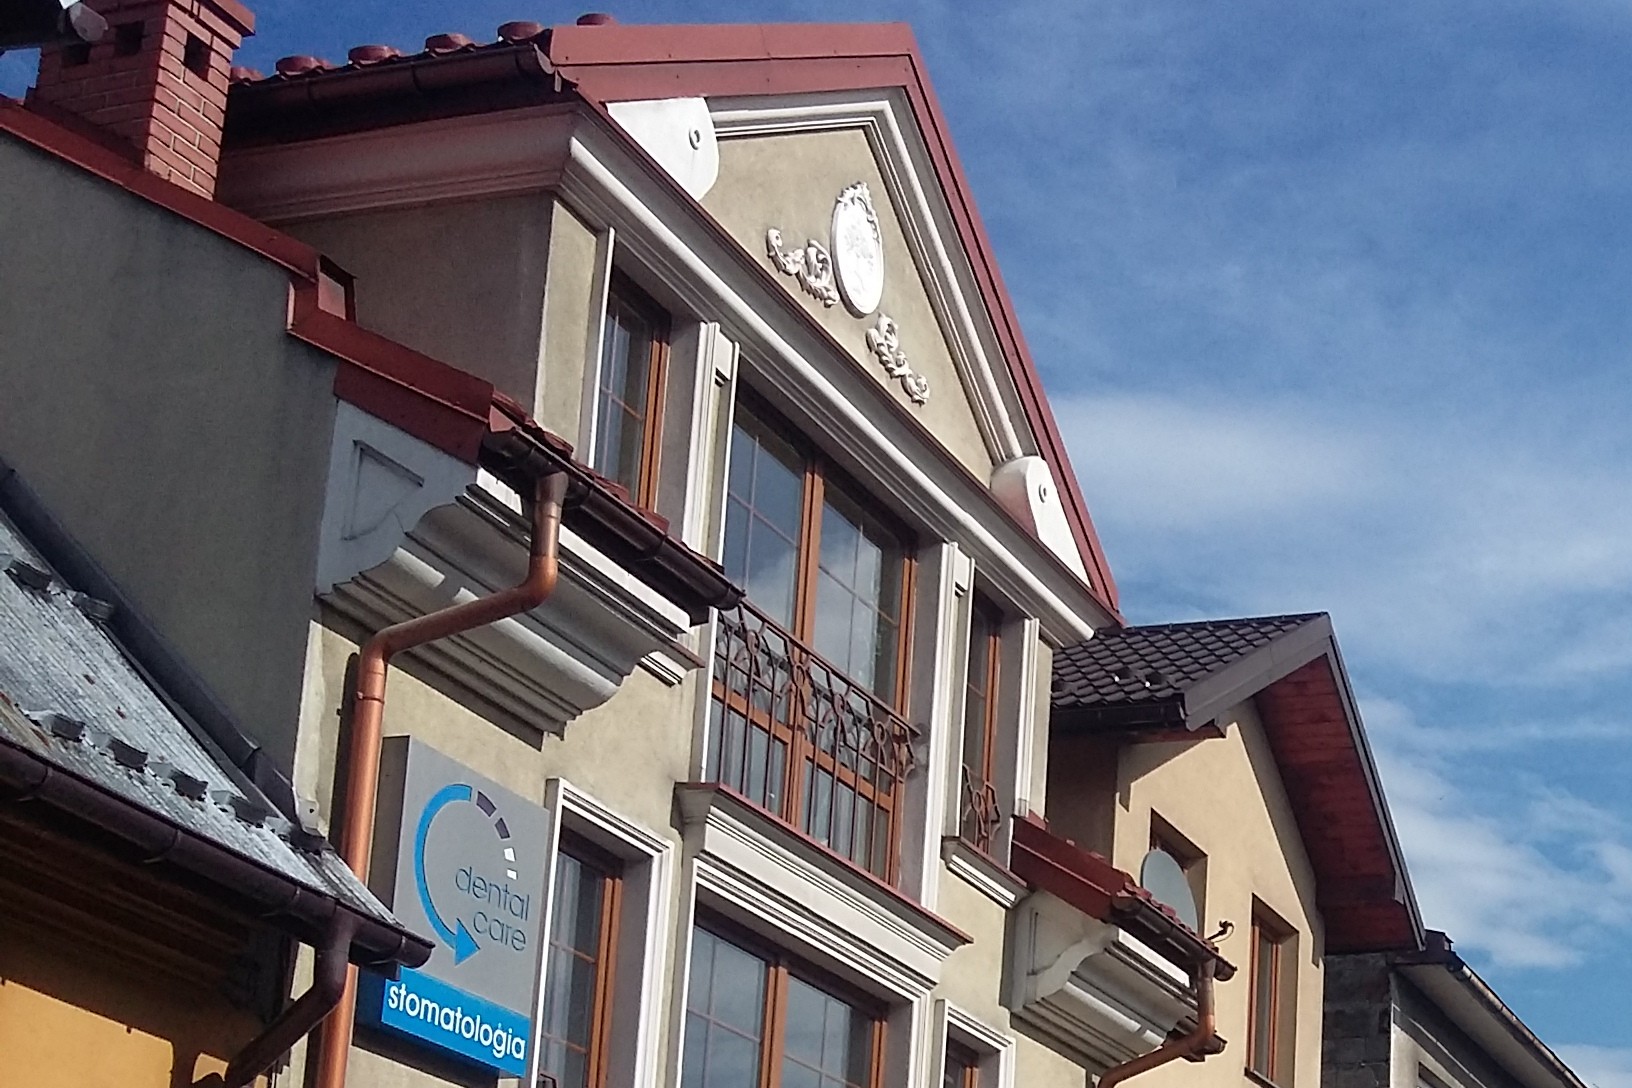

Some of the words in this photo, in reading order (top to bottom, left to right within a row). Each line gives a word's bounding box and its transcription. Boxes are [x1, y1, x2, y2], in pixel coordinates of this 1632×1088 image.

[455, 865, 530, 921] dental
[472, 909, 526, 952] care
[387, 980, 527, 1060] stomatologia
